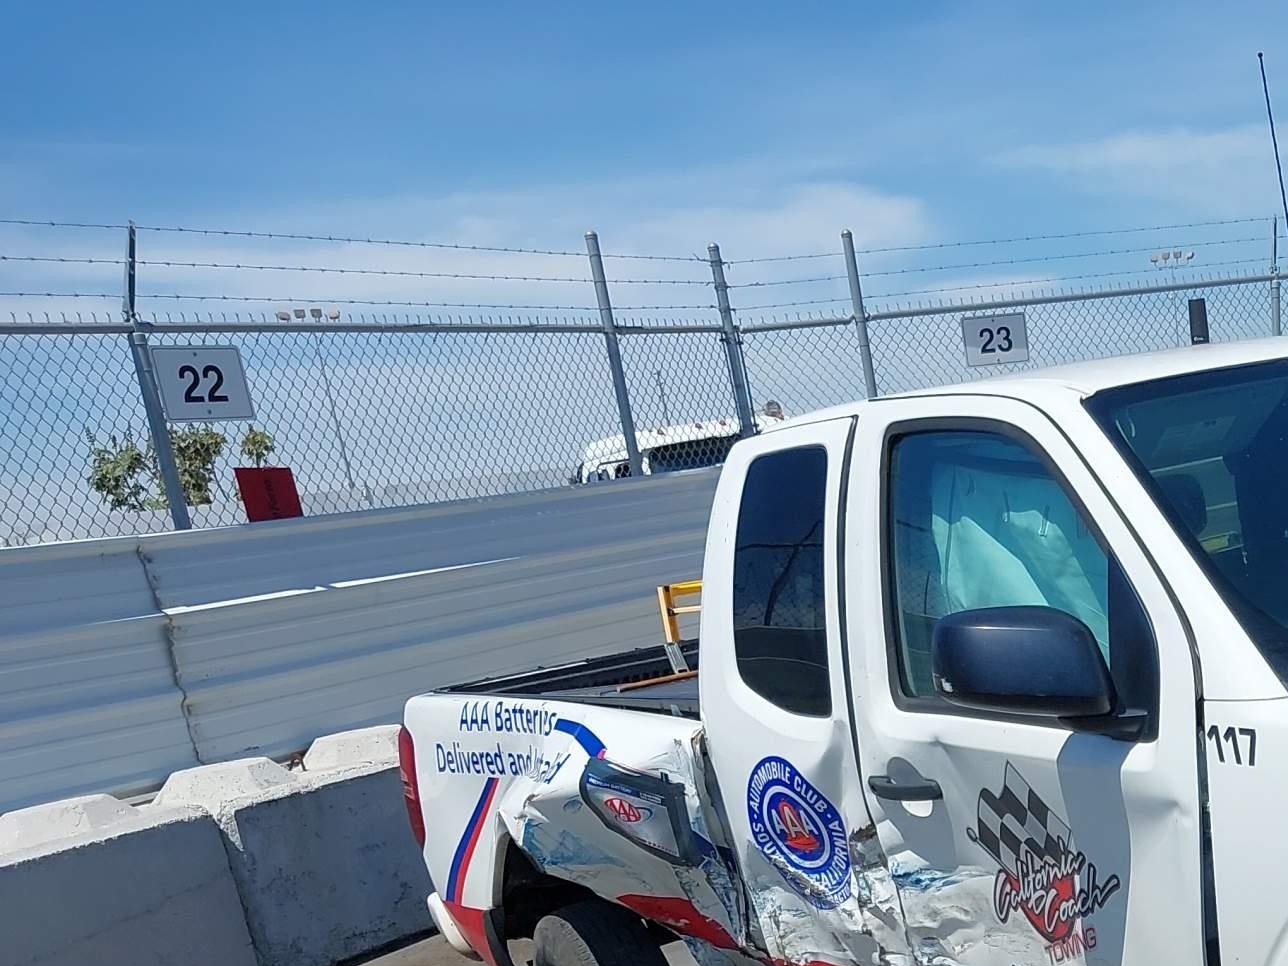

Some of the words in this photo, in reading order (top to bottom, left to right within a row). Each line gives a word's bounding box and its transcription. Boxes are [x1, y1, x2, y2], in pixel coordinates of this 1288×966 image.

[979, 326, 1013, 354] 23
[178, 364, 229, 403] 22
[459, 700, 491, 732] AAA
[435, 741, 506, 775] Delivered
[1206, 724, 1257, 767] 117
[750, 761, 792, 814] AUTOMOBILE
[793, 775, 828, 813] CLUB
[604, 797, 641, 822] AAA
[771, 805, 819, 838] AAA
[994, 835, 1086, 924] California
[1042, 862, 1121, 933] Coach
